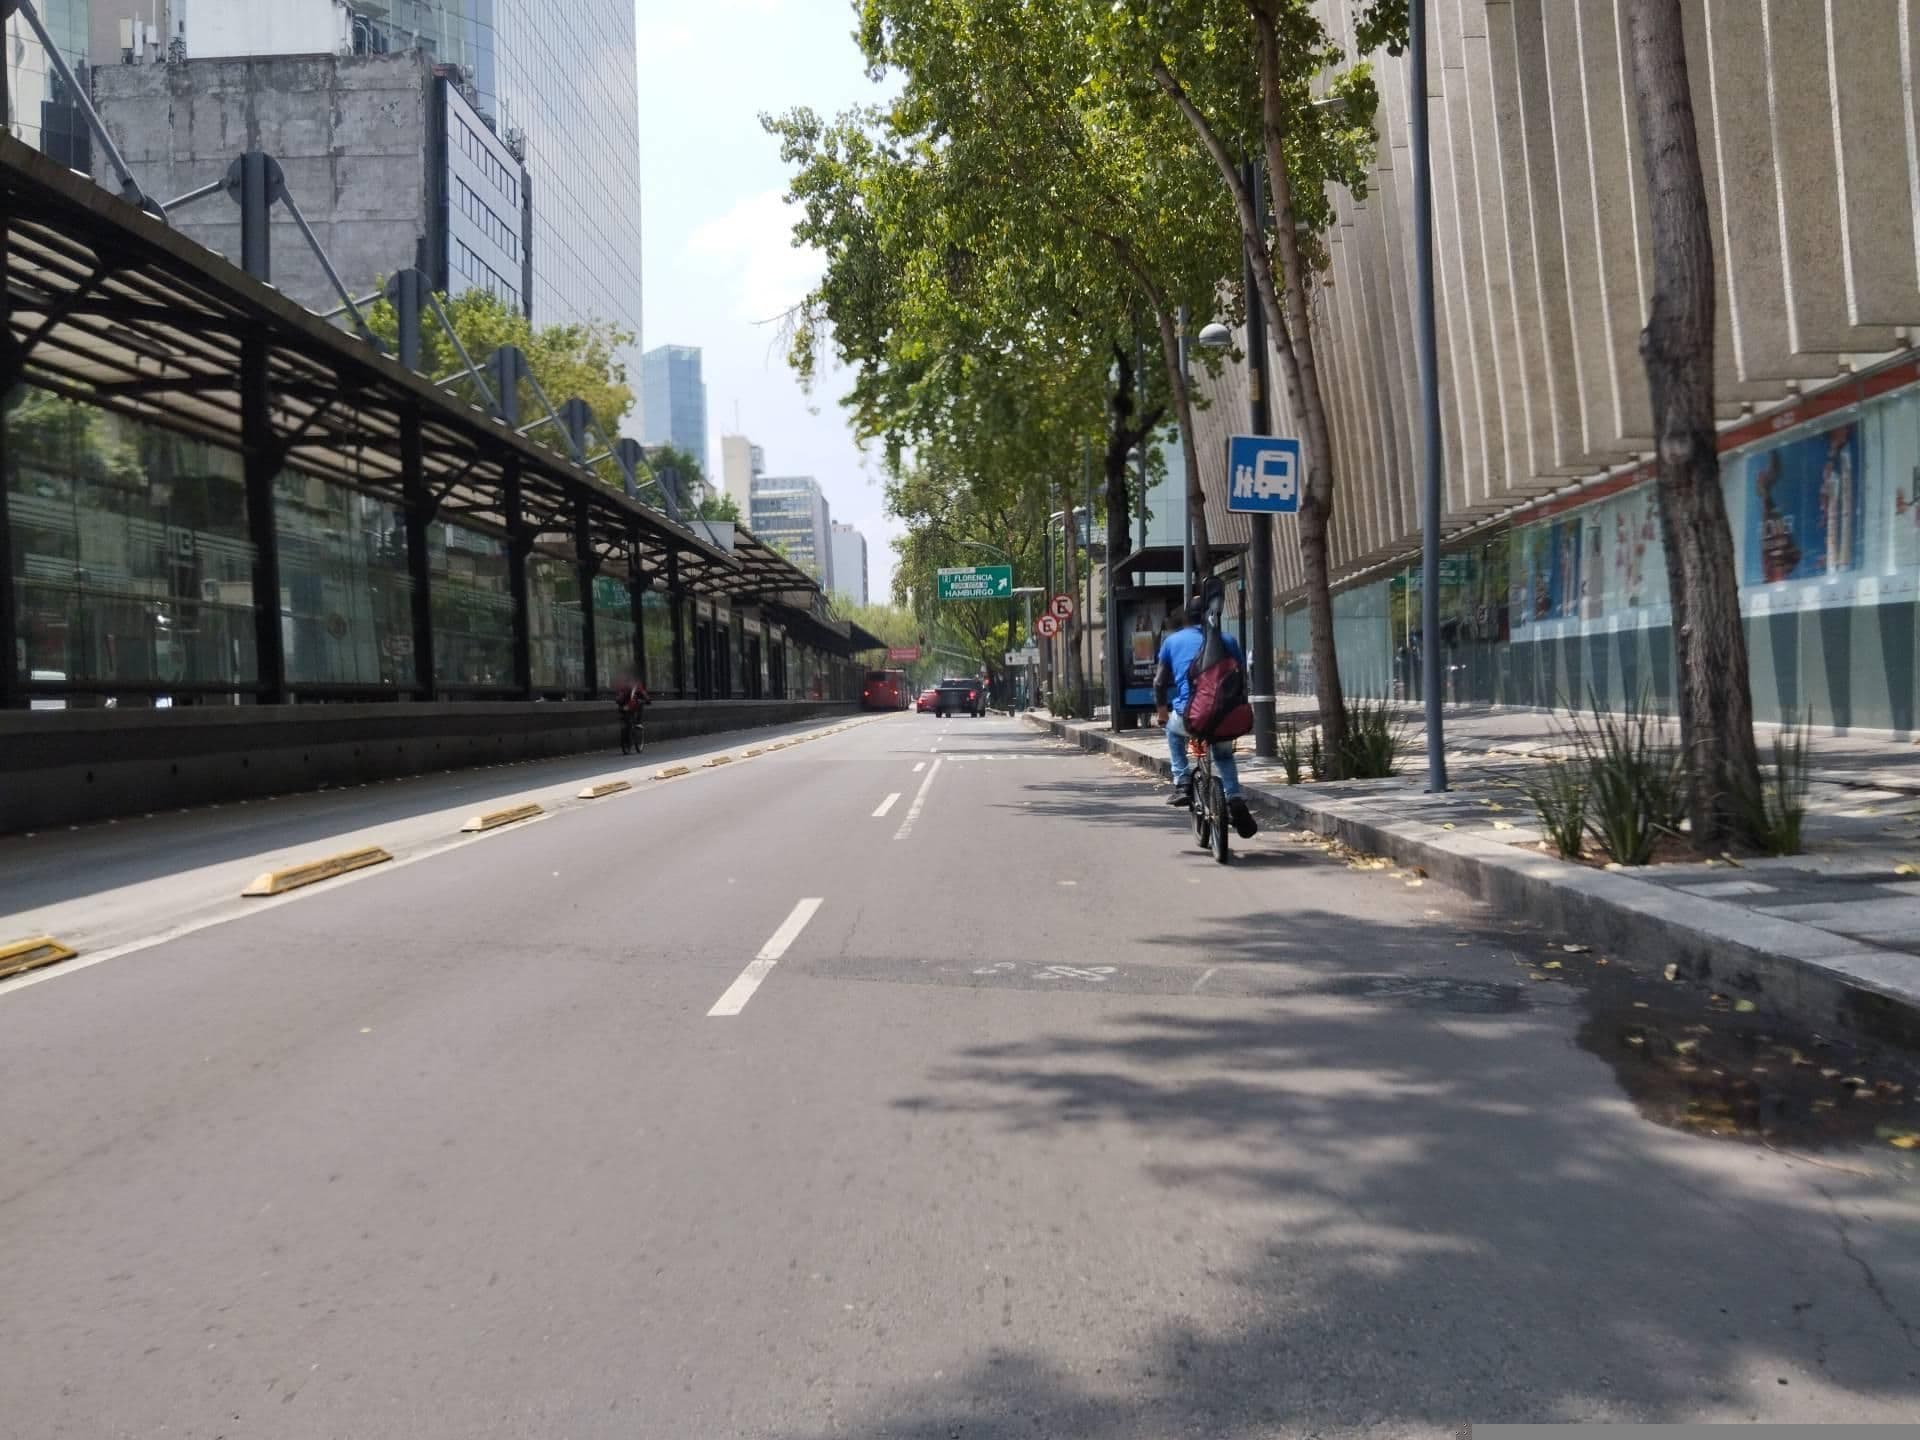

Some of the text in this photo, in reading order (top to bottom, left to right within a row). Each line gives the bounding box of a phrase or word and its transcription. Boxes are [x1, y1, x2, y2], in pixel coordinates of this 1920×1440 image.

[954, 574, 993, 582] FLORENCIA
[945, 588, 994, 597] HAMBURGO
[1057, 599, 1069, 614] E
